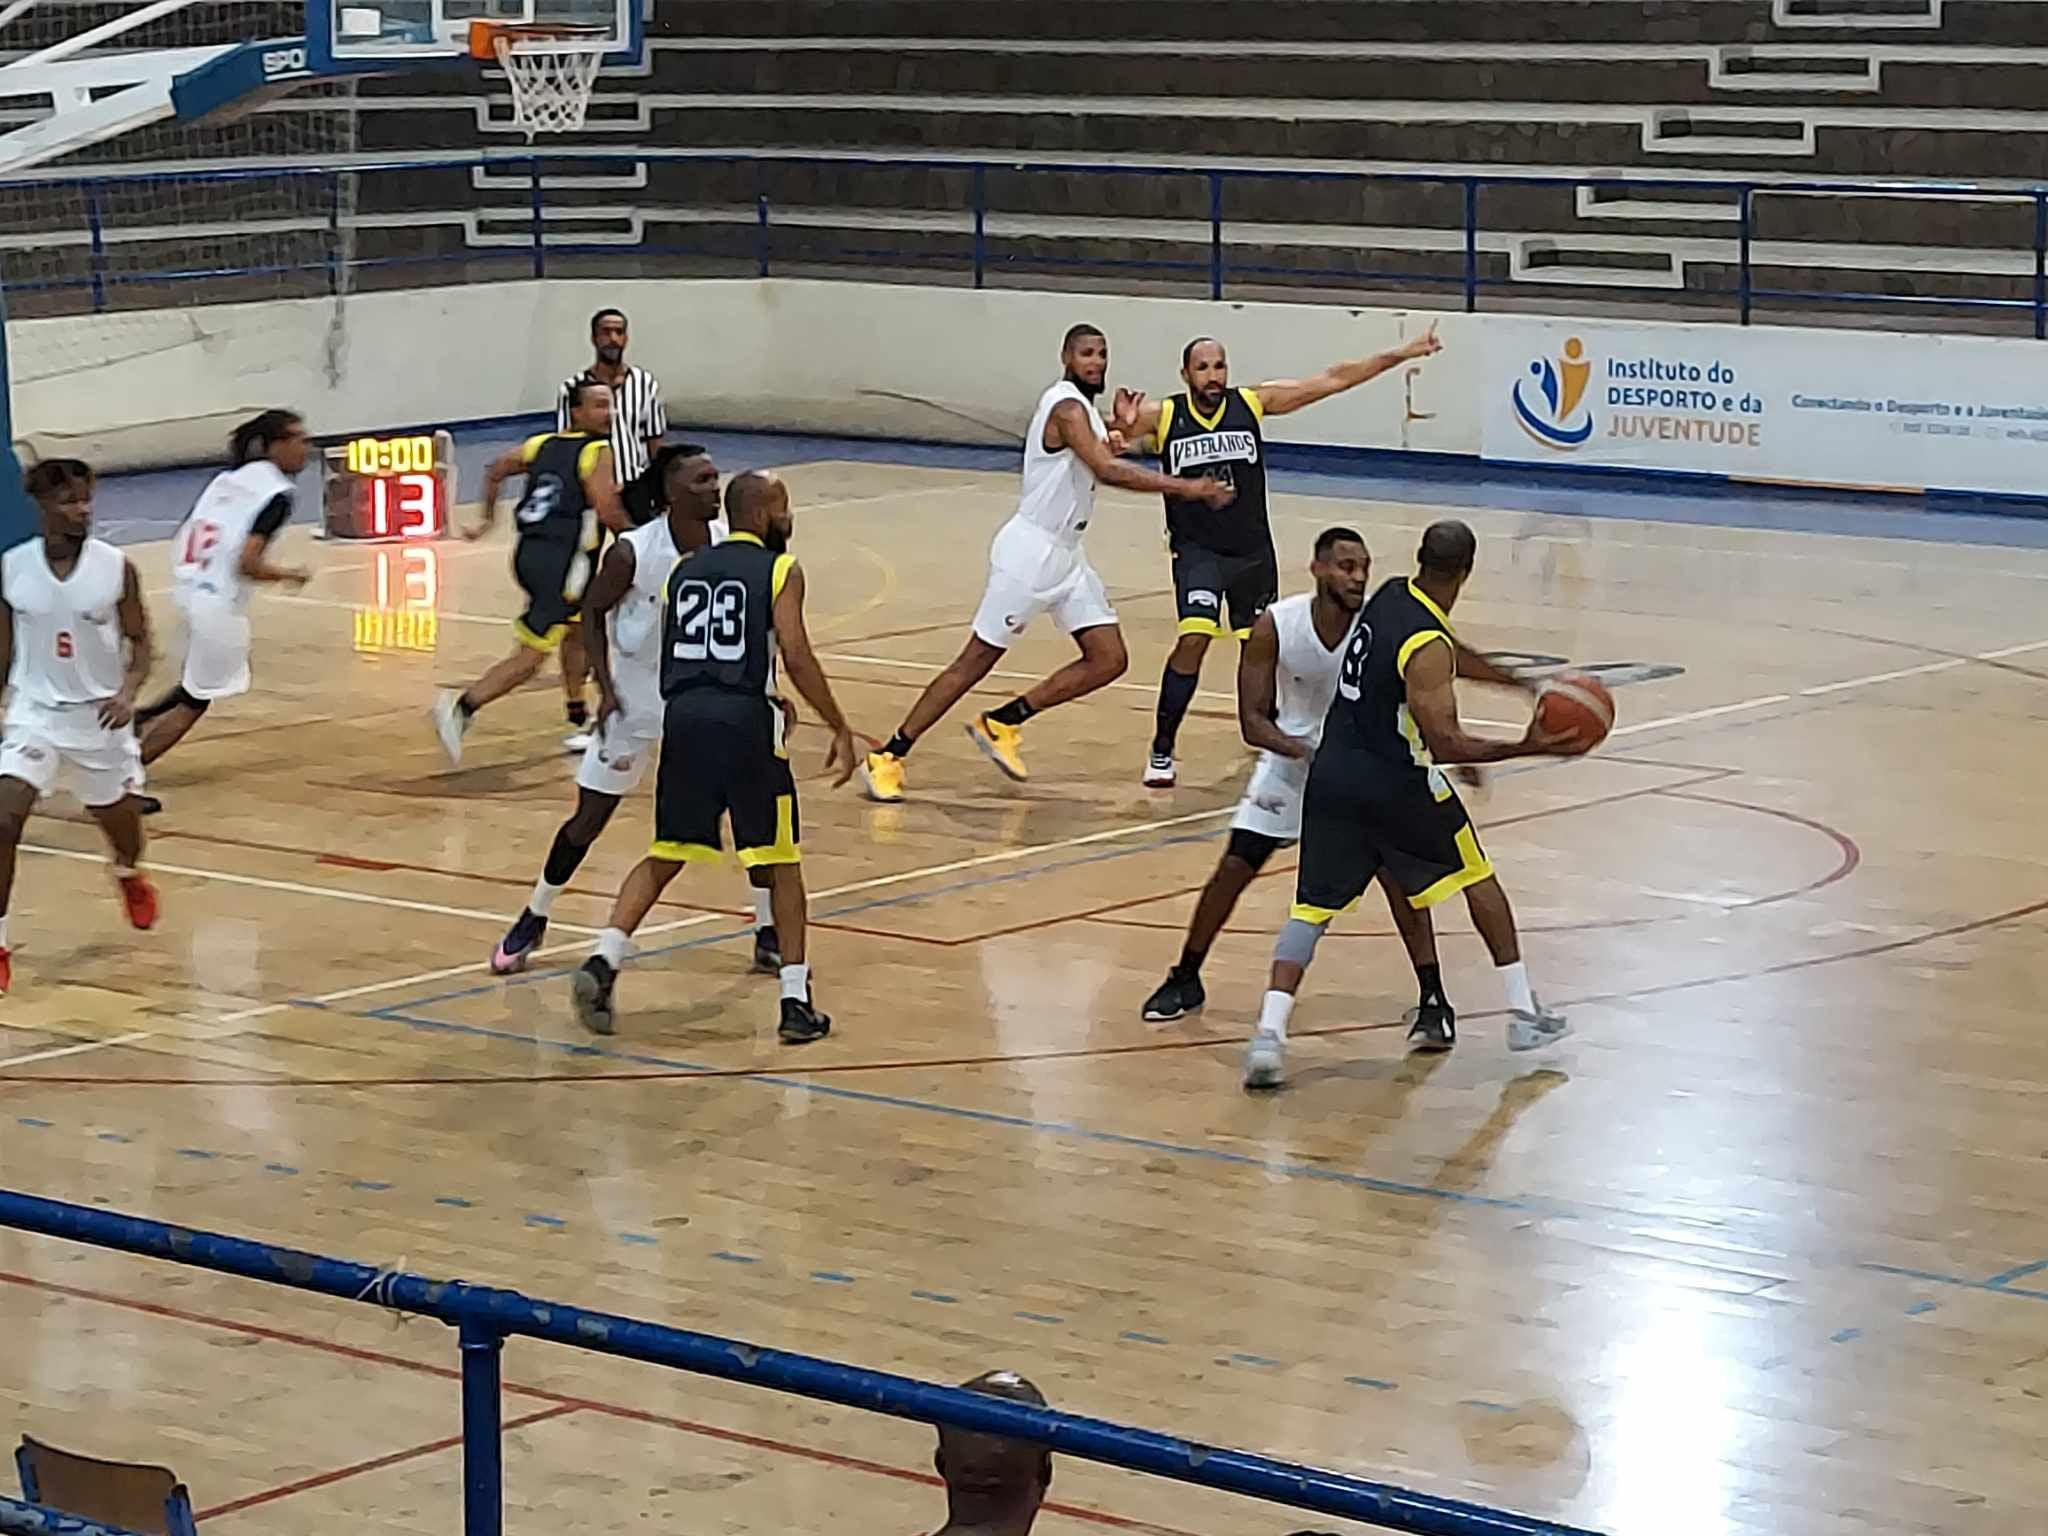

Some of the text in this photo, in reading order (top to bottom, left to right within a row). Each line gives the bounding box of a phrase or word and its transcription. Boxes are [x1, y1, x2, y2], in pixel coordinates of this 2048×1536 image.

[1607, 357, 1735, 384] Instituto do
[1607, 386, 1763, 414] DESPORTO e da
[1607, 414, 1762, 447] JUVENTUDE
[347, 435, 433, 474] 10:00
[373, 474, 435, 537] 13
[673, 579, 747, 661] 23
